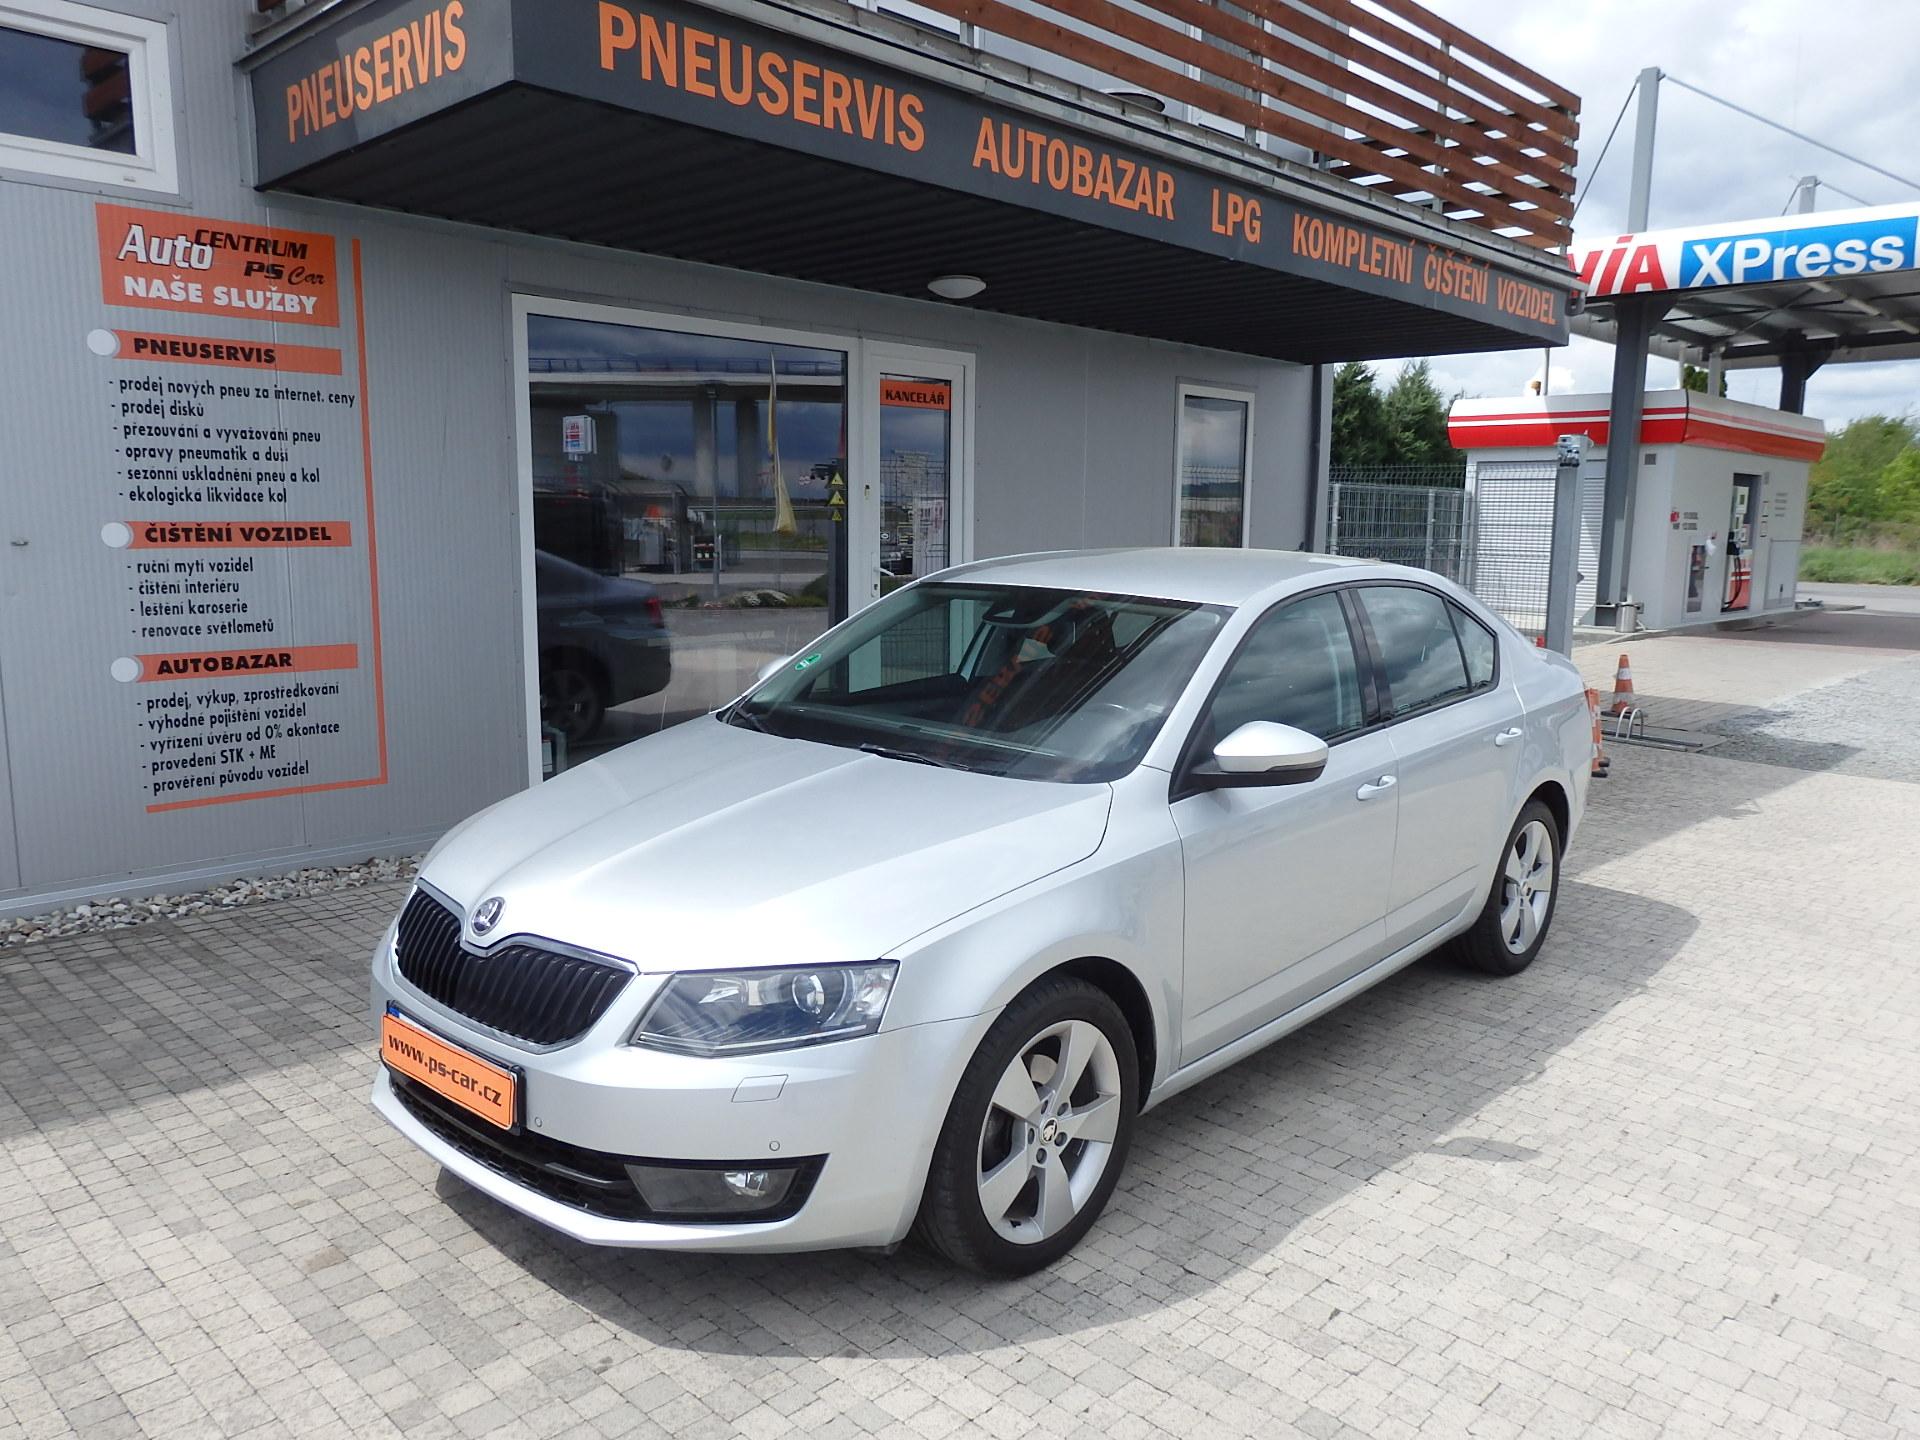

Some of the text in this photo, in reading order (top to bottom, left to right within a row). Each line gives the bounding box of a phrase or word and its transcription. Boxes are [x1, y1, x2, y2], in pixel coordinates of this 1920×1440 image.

[287, 0, 466, 143] PNEUSERVIS
[599, 1, 1557, 325] PNEUSERVIS AUTOBAZAR LPG KOMPLETNÍ ČIŠTĚNÍ VOZIDEL
[117, 223, 308, 271] Auto CENTRUM
[1688, 235, 1905, 288] XPress
[244, 261, 326, 285] PS Car
[124, 274, 318, 314] NAŠE SLUŽBY
[134, 338, 276, 363] PNEUSERVIS
[120, 376, 163, 396] prodej
[168, 379, 215, 399] nových
[220, 385, 250, 400] pneu
[255, 388, 269, 399] za
[274, 384, 325, 402] internet.
[328, 393, 355, 408] ceny
[885, 389, 945, 405] KANCELÁŘ
[122, 398, 165, 419] prodej
[203, 428, 211, 438] a
[292, 431, 321, 445] pneu
[125, 447, 173, 463] opravy
[179, 445, 247, 463] pneumatik
[253, 451, 260, 460] a
[256, 471, 285, 485] pneu
[290, 472, 297, 482] a
[301, 467, 320, 482] kol
[207, 486, 264, 502] likvidace
[268, 487, 287, 503] kol
[145, 522, 332, 542] ČIŠTĚNÍ VOZIDEL
[209, 556, 253, 572] vozidel
[188, 598, 248, 615] karoserie
[142, 624, 201, 638] renovace
[157, 653, 292, 675] AUTOBAZAR
[147, 692, 191, 713] prodej,
[264, 702, 306, 719] vozidel
[246, 725, 260, 741] od
[265, 724, 283, 739] 0%
[286, 722, 340, 737] akontace
[220, 748, 244, 764] STK
[260, 745, 276, 760] ME
[267, 760, 309, 778] vozidel
[388, 1034, 502, 1107] www.ps-car.cz
